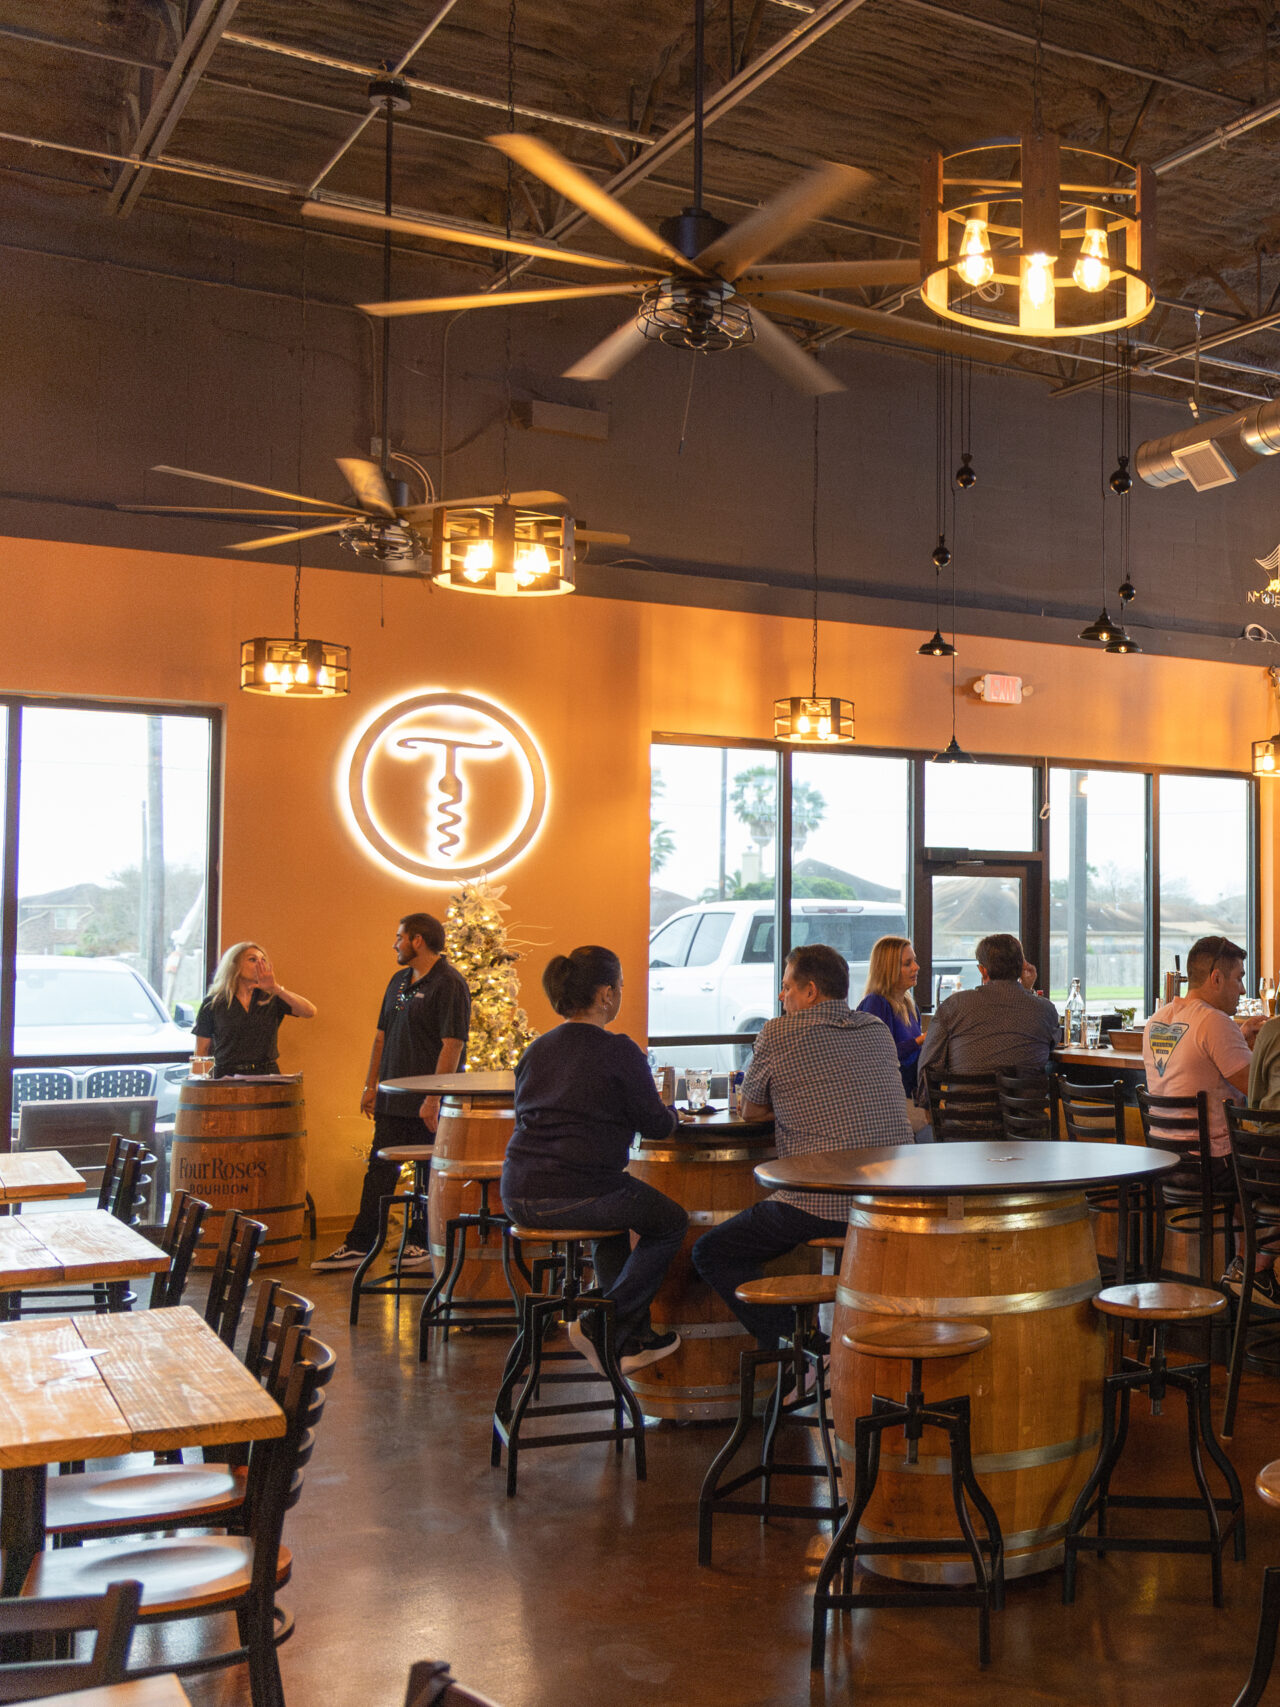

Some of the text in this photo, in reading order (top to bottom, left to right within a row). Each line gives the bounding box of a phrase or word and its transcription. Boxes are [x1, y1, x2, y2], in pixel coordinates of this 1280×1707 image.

[179, 1156, 268, 1181] Four Roses
[189, 1184, 249, 1195] BOURBON
